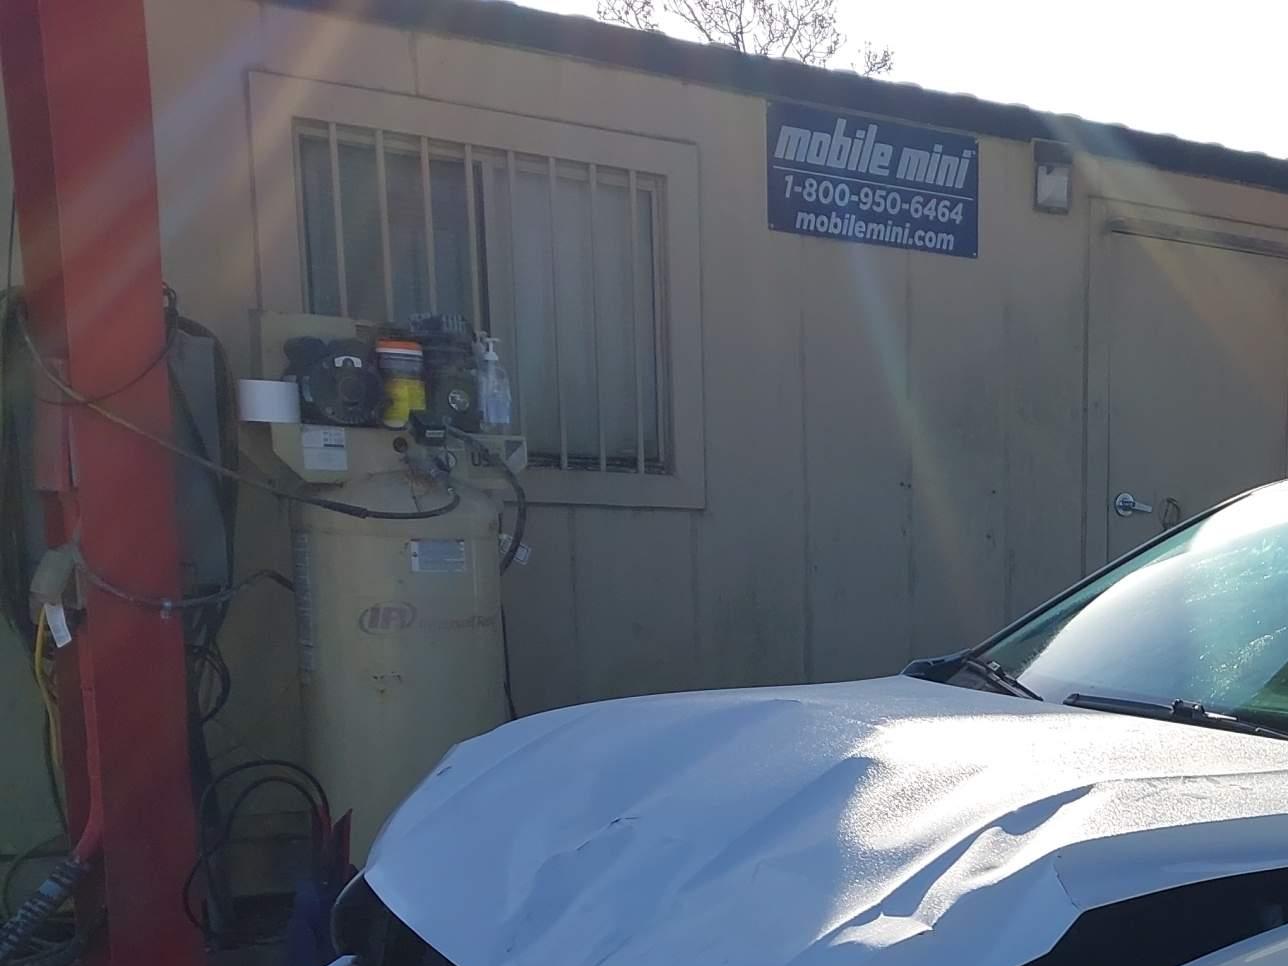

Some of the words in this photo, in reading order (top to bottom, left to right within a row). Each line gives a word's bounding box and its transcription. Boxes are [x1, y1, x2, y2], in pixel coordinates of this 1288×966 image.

[773, 117, 894, 177] mobile
[896, 143, 971, 190] mini
[783, 174, 964, 225] 1-800-950-6464
[794, 209, 955, 251] mobilemini.com
